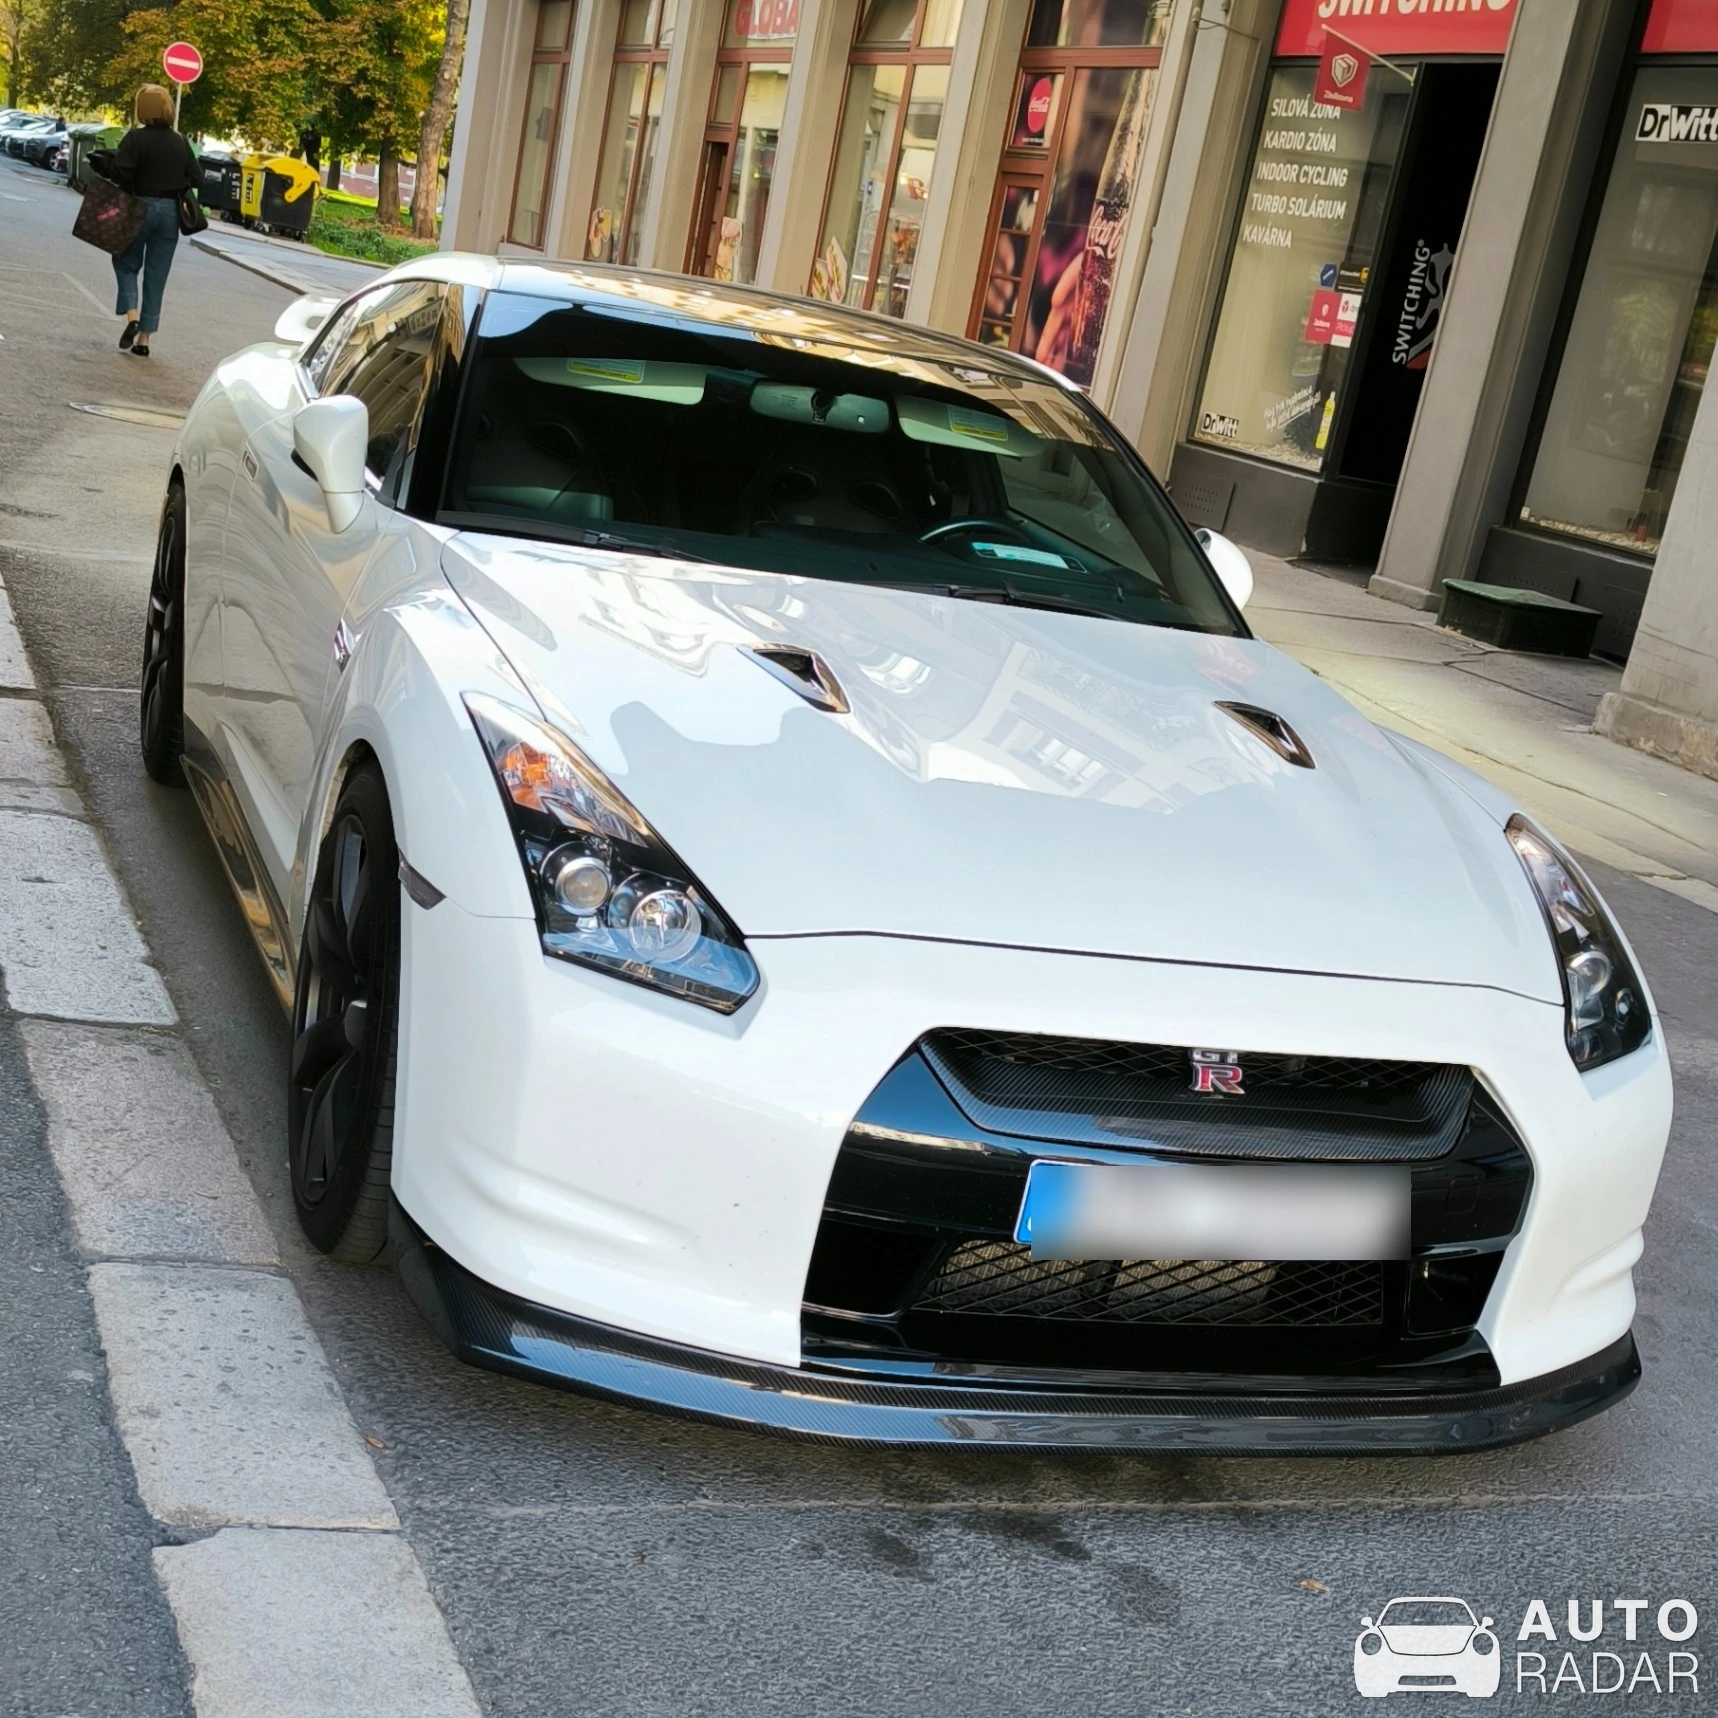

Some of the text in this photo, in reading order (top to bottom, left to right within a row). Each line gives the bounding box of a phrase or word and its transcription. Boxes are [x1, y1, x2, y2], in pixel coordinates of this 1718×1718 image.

[1271, 94, 1310, 118] SILOVÁ
[1263, 127, 1337, 153] KARDIO ZÓNA
[1257, 162, 1348, 187] INDOOR CYCLING
[1251, 193, 1347, 219] TURBO SOLÁRIUM
[1242, 221, 1292, 248] KAVÁRNA
